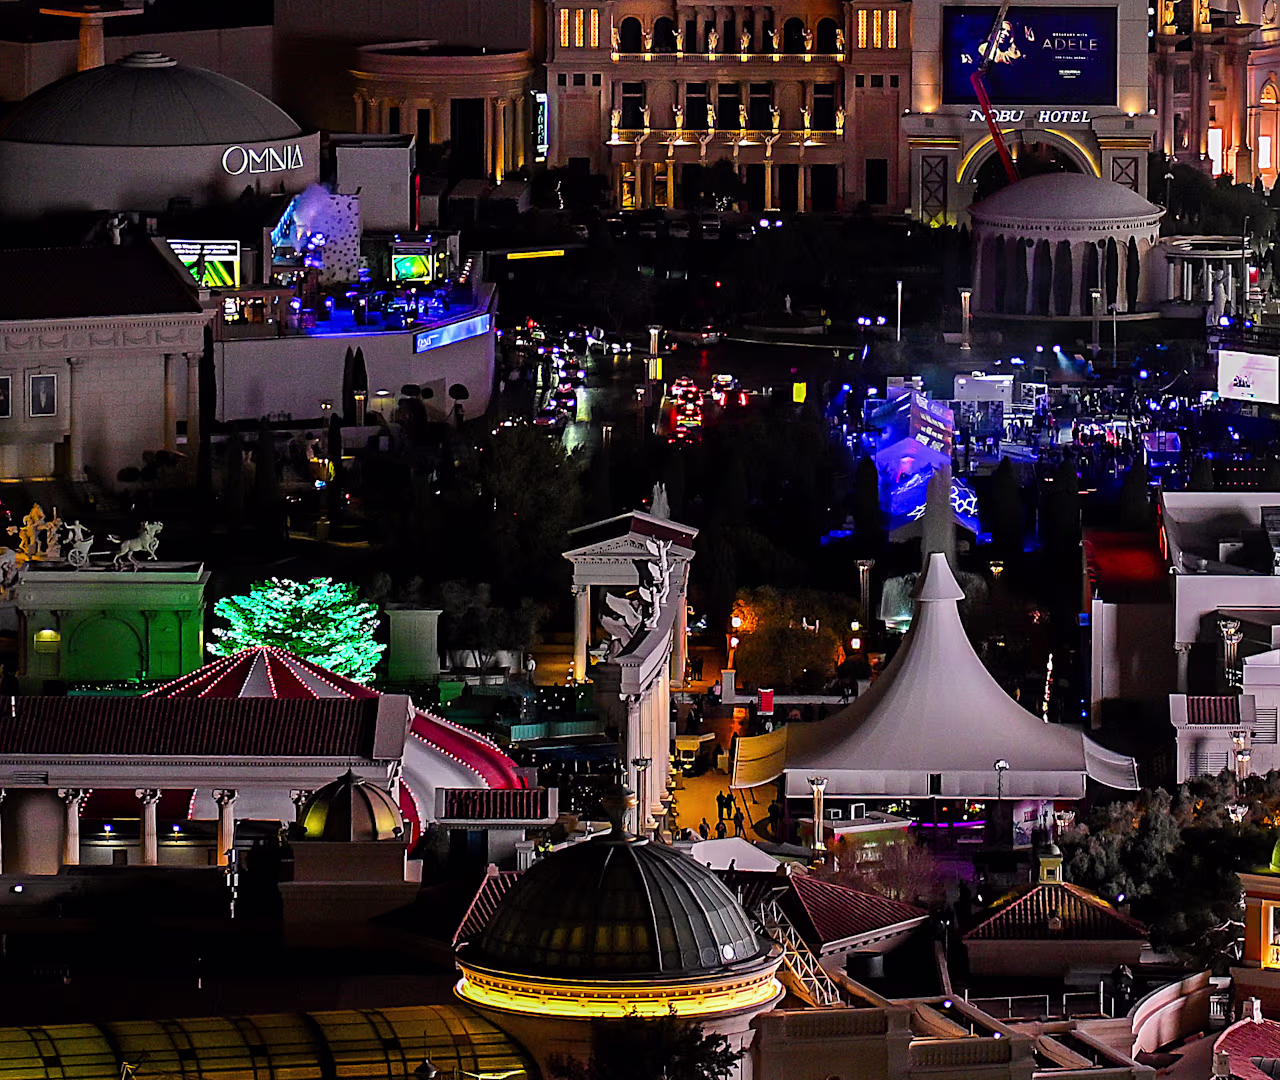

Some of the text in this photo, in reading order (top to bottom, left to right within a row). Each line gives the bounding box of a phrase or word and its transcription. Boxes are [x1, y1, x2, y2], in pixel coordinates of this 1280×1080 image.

[1041, 38, 1098, 51] ADELE
[1038, 109, 1091, 123] HOTEL
[221, 143, 304, 176] OMNIA
